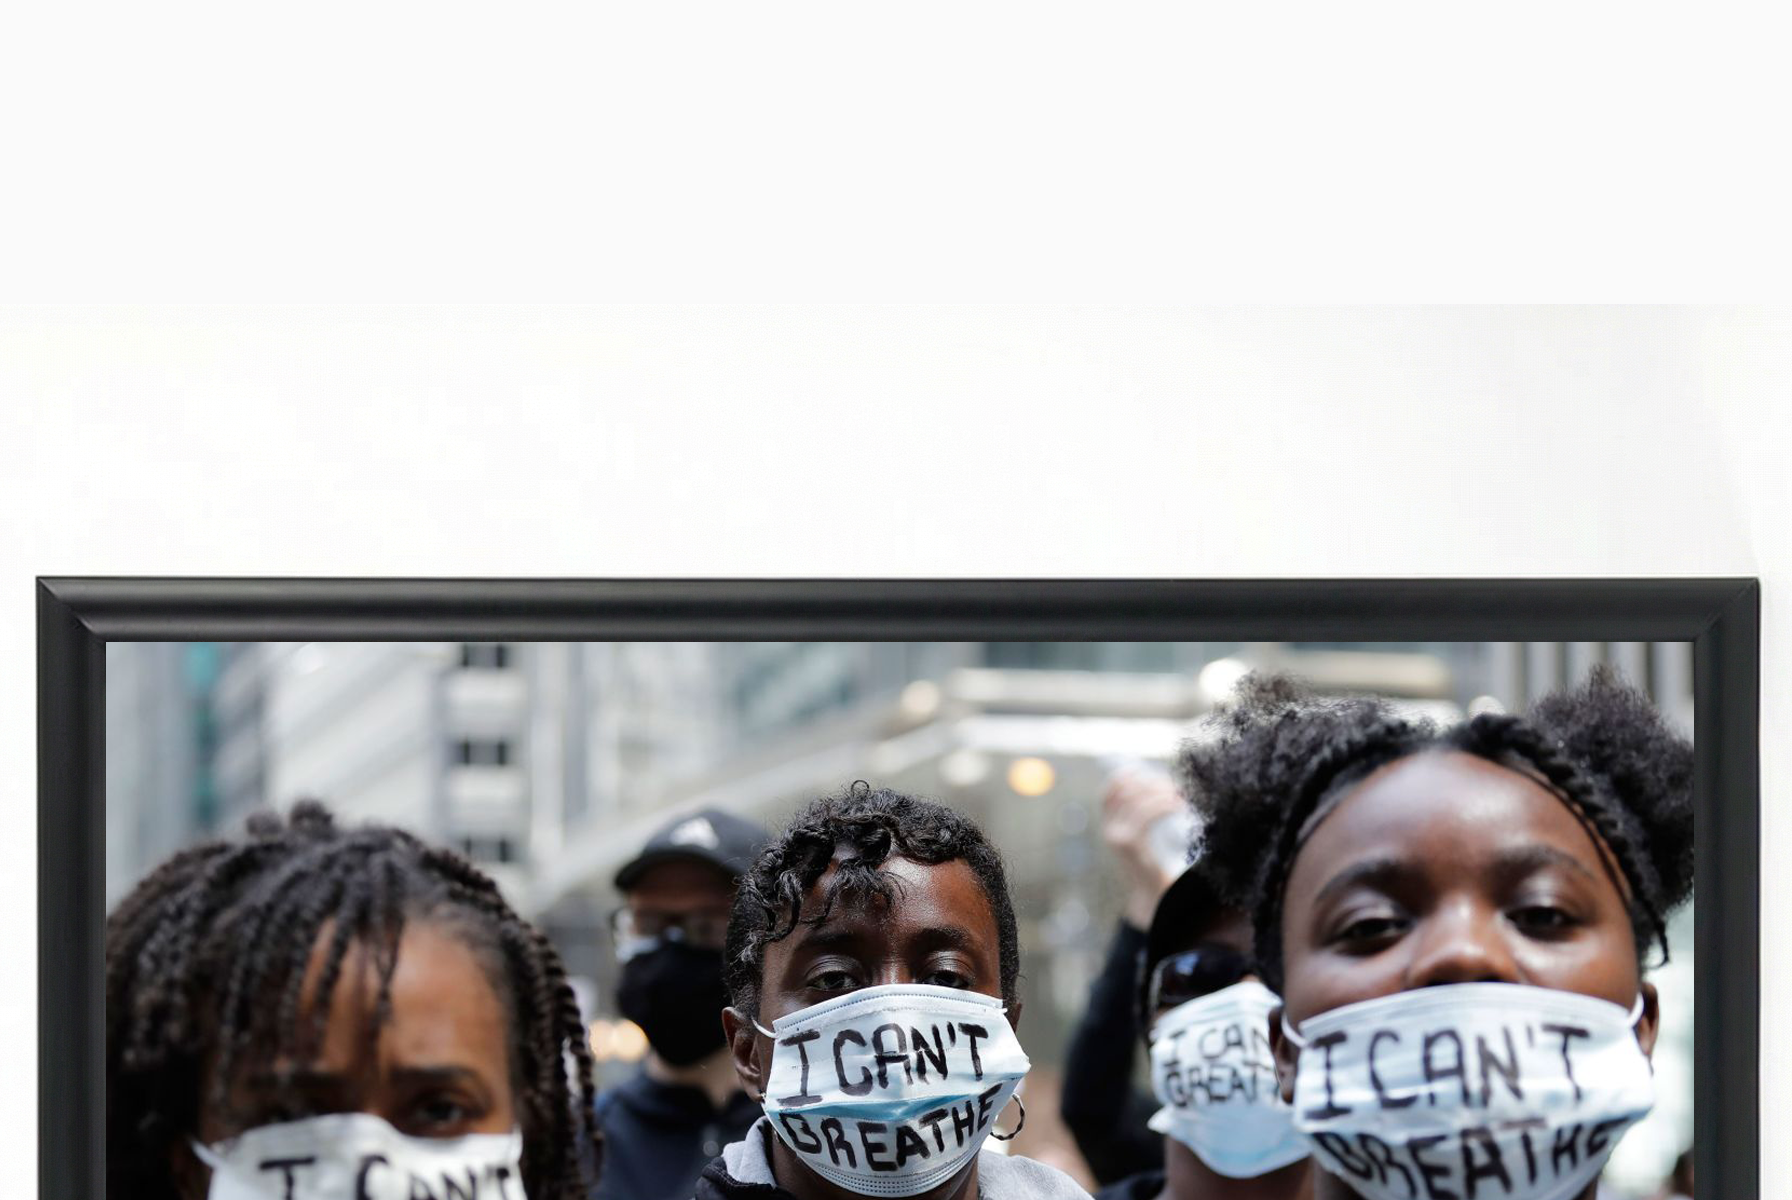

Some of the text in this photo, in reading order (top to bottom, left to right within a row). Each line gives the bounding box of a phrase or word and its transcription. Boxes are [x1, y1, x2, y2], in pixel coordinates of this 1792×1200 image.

[777, 1021, 989, 1107] I CAN'T
[1304, 1024, 1592, 1120] I CAN'T
[778, 1082, 1004, 1172] BREATHE
